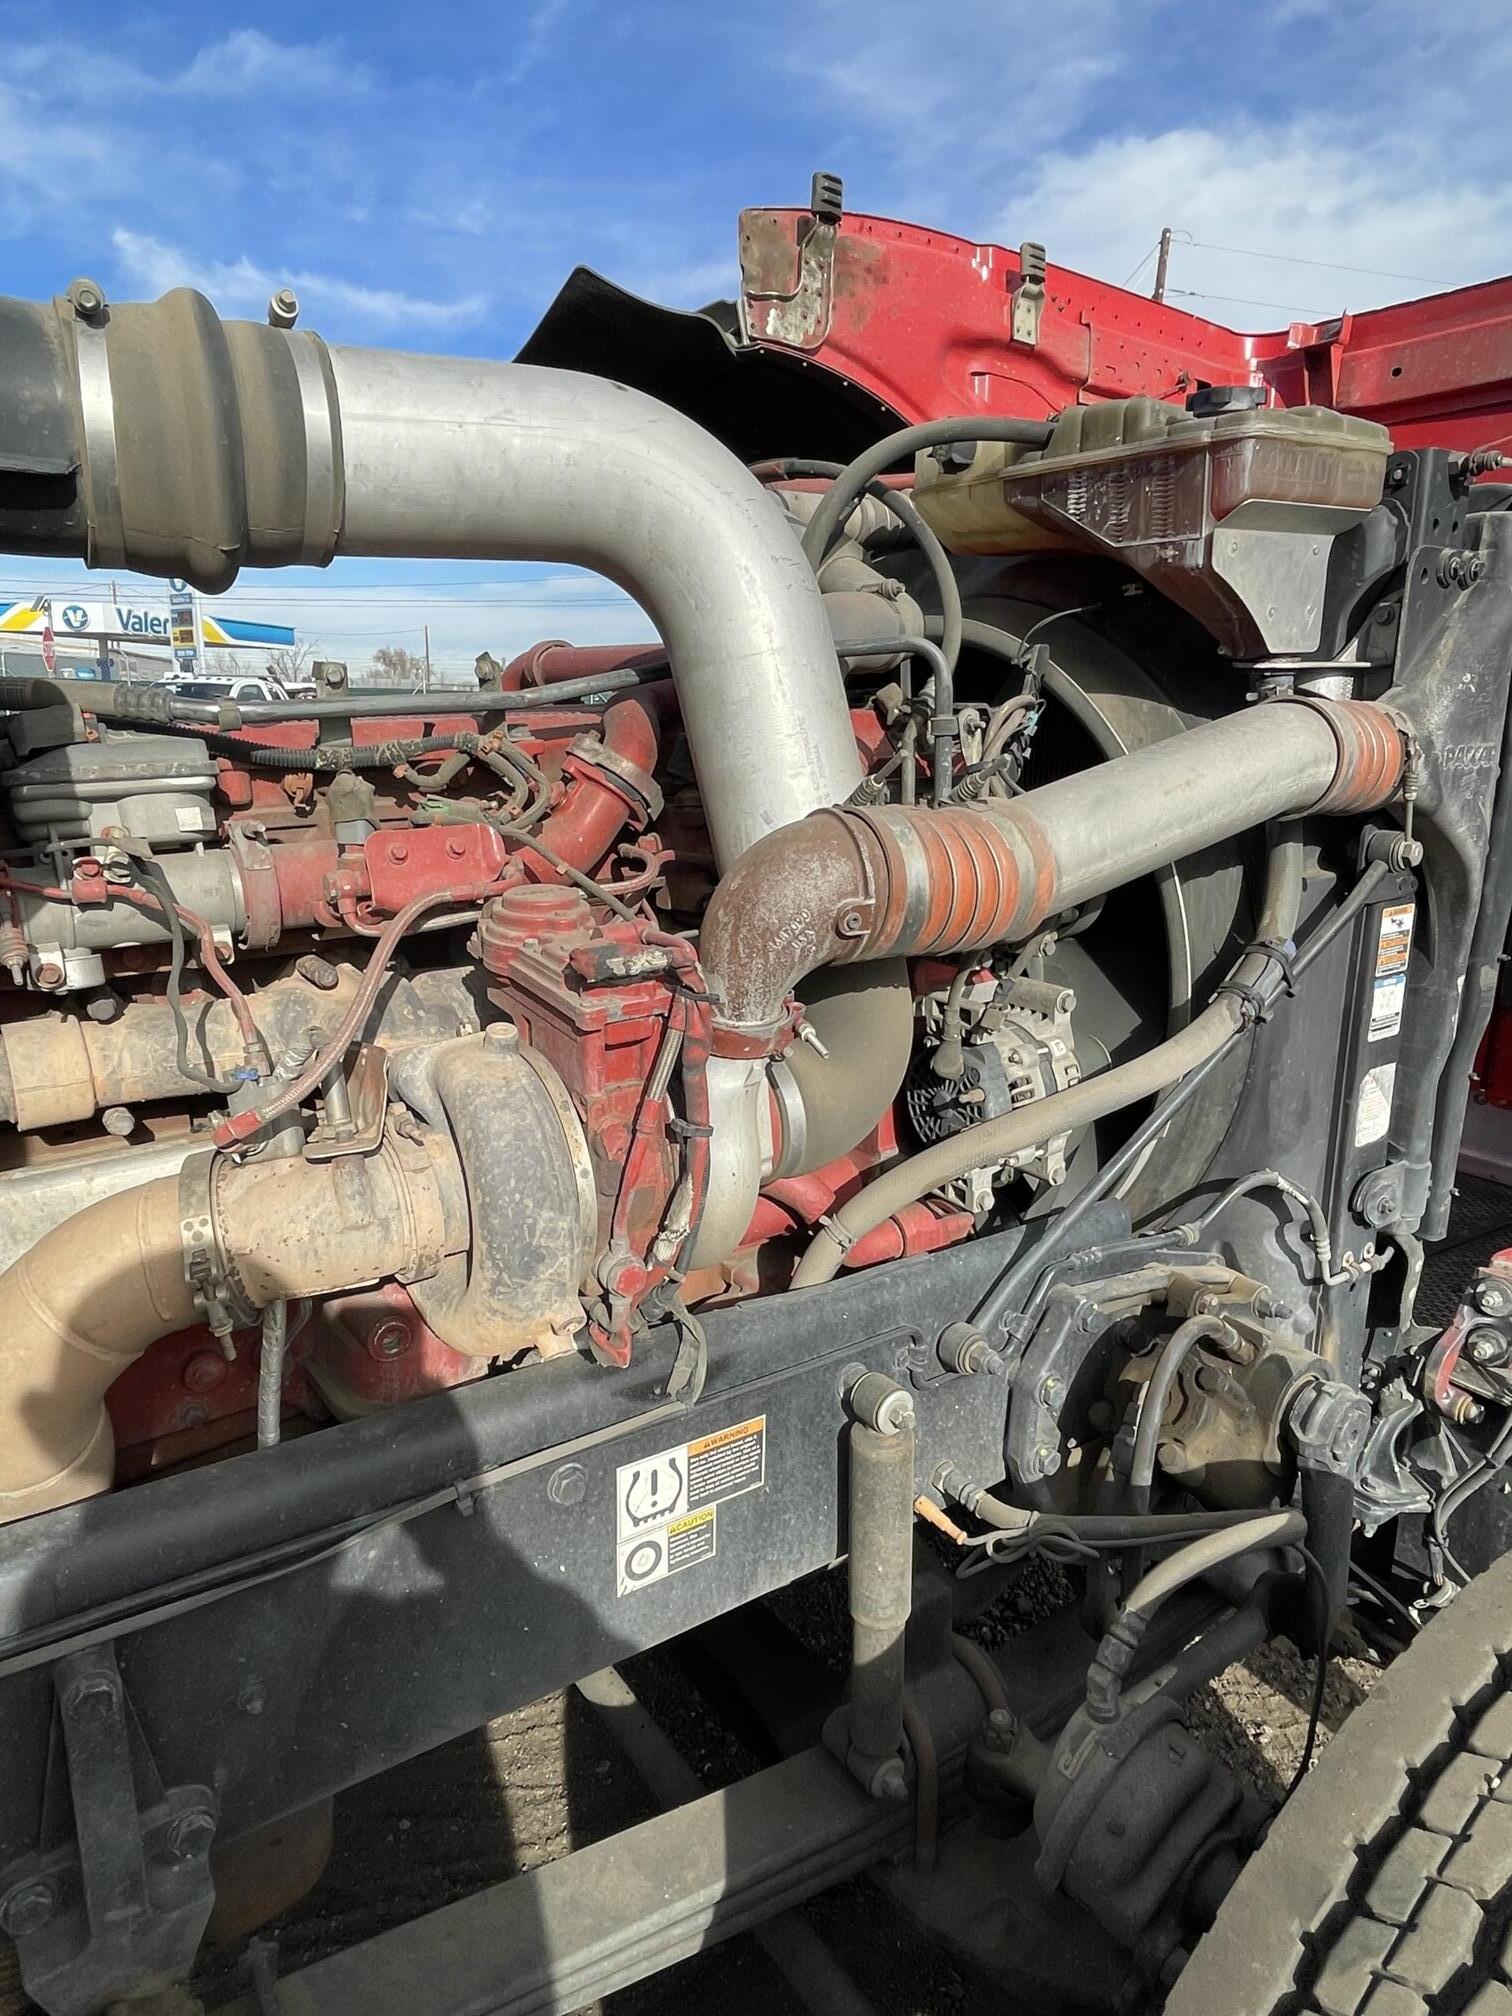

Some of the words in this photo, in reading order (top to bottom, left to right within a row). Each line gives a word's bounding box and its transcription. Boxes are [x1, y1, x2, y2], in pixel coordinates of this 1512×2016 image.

[115, 607, 170, 636] Valer
[709, 1426, 749, 1446] WARNING
[676, 1510, 713, 1532] CAUTION
